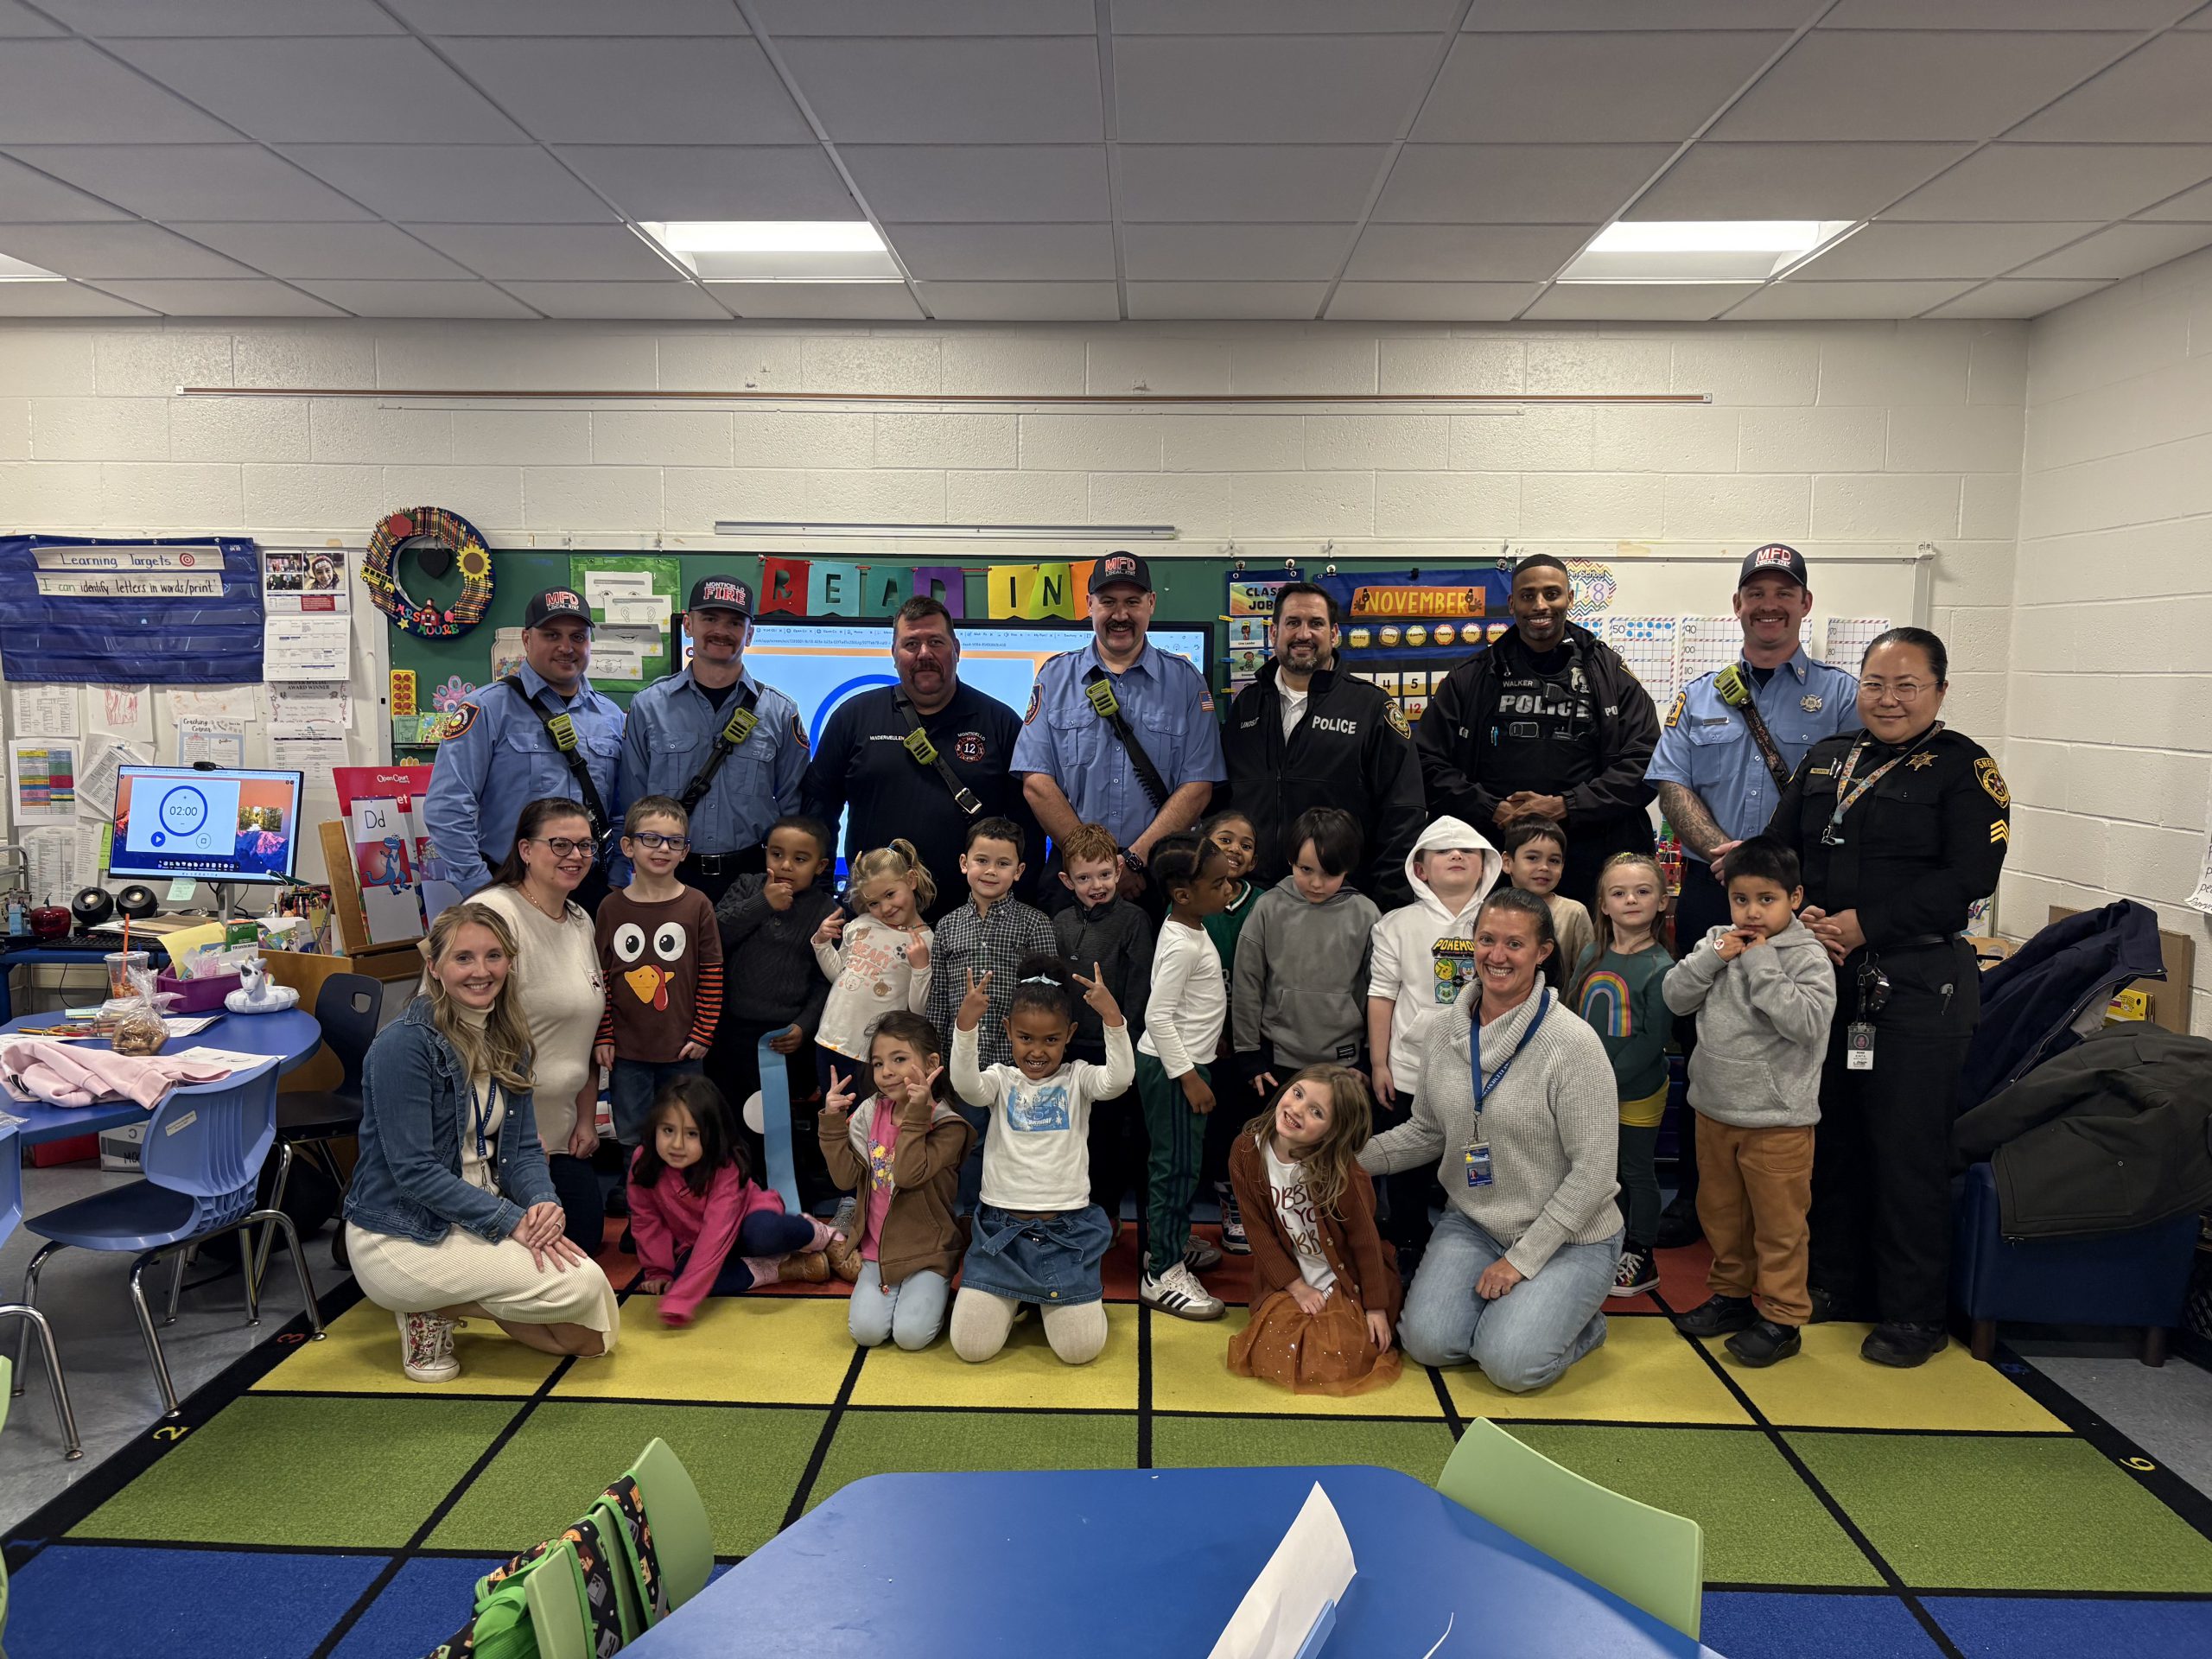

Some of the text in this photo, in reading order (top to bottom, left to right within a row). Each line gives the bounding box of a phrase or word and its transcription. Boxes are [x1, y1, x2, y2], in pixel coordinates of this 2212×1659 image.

[60, 552, 171, 569] Learning Targets
[1756, 547, 1791, 561] MFD
[1105, 556, 1136, 571] MFD
[1580, 569, 1605, 579] School
[43, 578, 51, 591] I
[80, 581, 110, 594] identify
[116, 580, 146, 594] letters
[150, 582, 158, 593] in
[705, 582, 745, 593] MONTICELLO
[545, 591, 579, 606] MFD
[703, 587, 746, 606] FIRE
[1366, 591, 1468, 614] NOVEMBER
[396, 603, 421, 622] MRS
[417, 624, 460, 637] MOORE
[1612, 624, 1625, 634] 50
[1685, 626, 1697, 634] 90
[1383, 679, 1390, 690] 4
[1411, 678, 1418, 689] 5
[1503, 679, 1534, 688] WALKER
[1409, 703, 1421, 714] 12
[1498, 694, 1591, 719] POLICE
[1312, 715, 1357, 734] POLICE
[957, 731, 986, 741] MONTICELLO
[963, 743, 976, 754] 12
[169, 806, 198, 817] 02:00
[365, 810, 385, 829] Dd
[852, 940, 894, 969] BEARY
[848, 956, 882, 982] CUTE
[153, 1426, 190, 1441] 2
